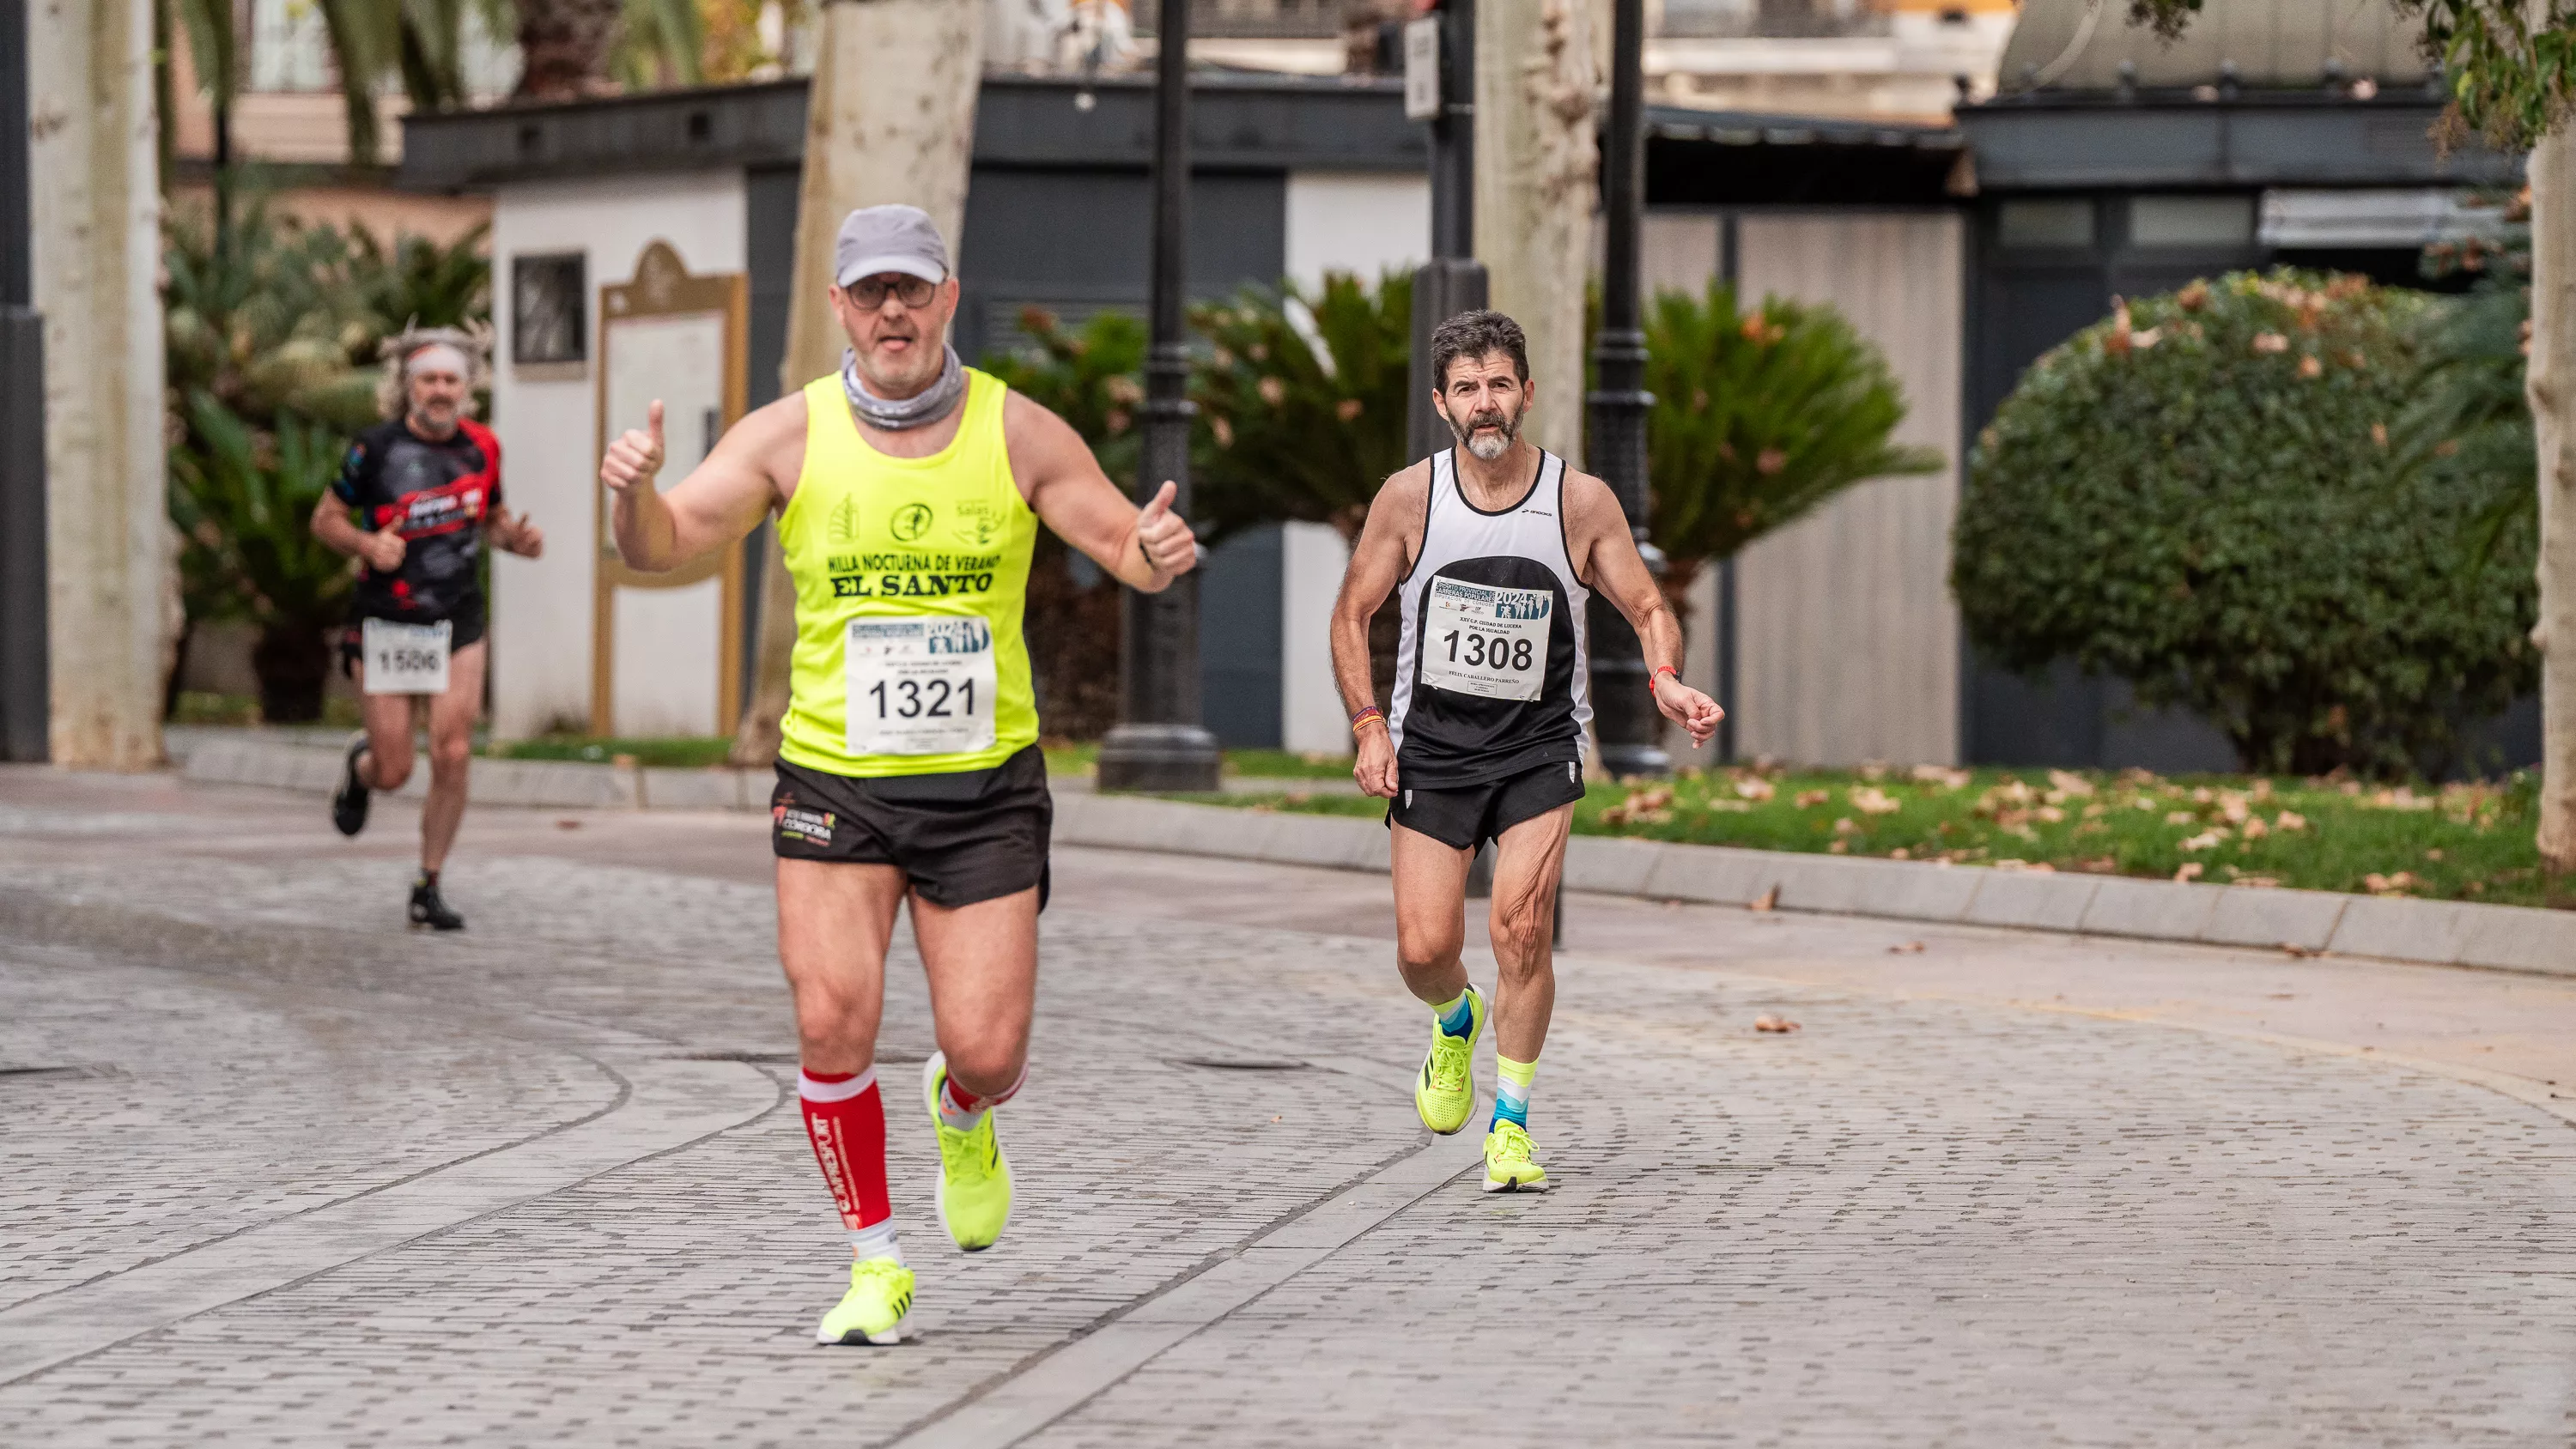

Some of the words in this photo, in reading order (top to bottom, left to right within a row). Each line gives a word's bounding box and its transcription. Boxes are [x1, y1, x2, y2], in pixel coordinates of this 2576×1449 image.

[864, 555, 931, 572] NOCTURNA
[936, 555, 951, 571] DE
[955, 554, 1001, 571] VERANO
[830, 575, 872, 597] EL
[881, 573, 993, 597] SANTO
[1459, 585, 1488, 597] PROVINCIAL
[1435, 586, 1462, 598] CARRERAS
[1464, 592, 1496, 603] POPULARES
[1495, 591, 1528, 604] 2024
[1444, 630, 1532, 671] 1308
[1463, 673, 1495, 682] CABALLERO
[870, 678, 975, 718] 1321
